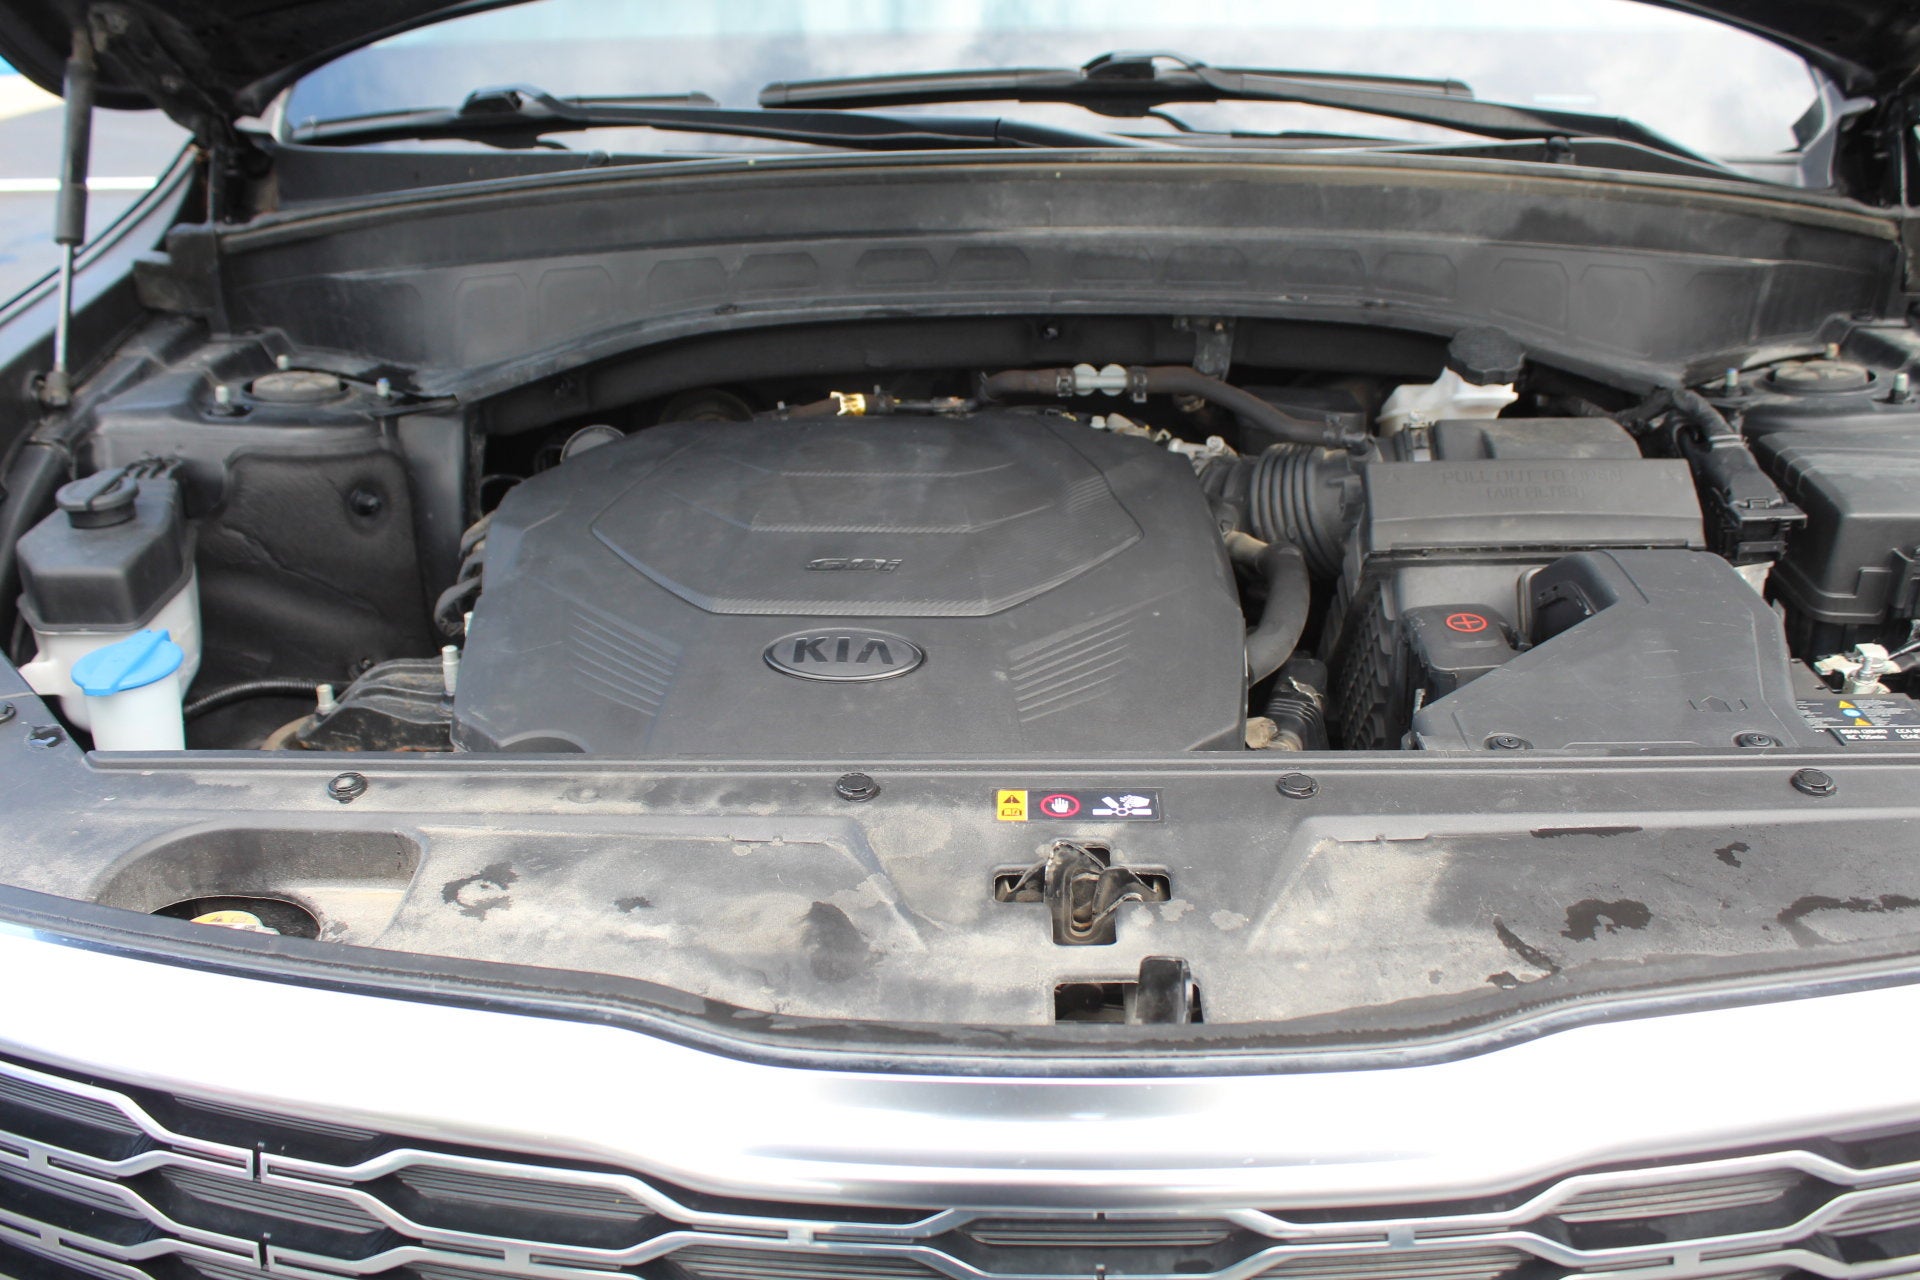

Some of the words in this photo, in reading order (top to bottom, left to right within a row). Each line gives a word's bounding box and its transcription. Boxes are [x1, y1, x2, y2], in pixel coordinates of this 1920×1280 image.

[1440, 469, 1492, 484] PULL
[1495, 469, 1533, 483] OUT
[1543, 469, 1566, 482] TO
[1572, 468, 1624, 483] OPEN
[1486, 486, 1520, 499] (AIR
[793, 637, 894, 665] KIA
